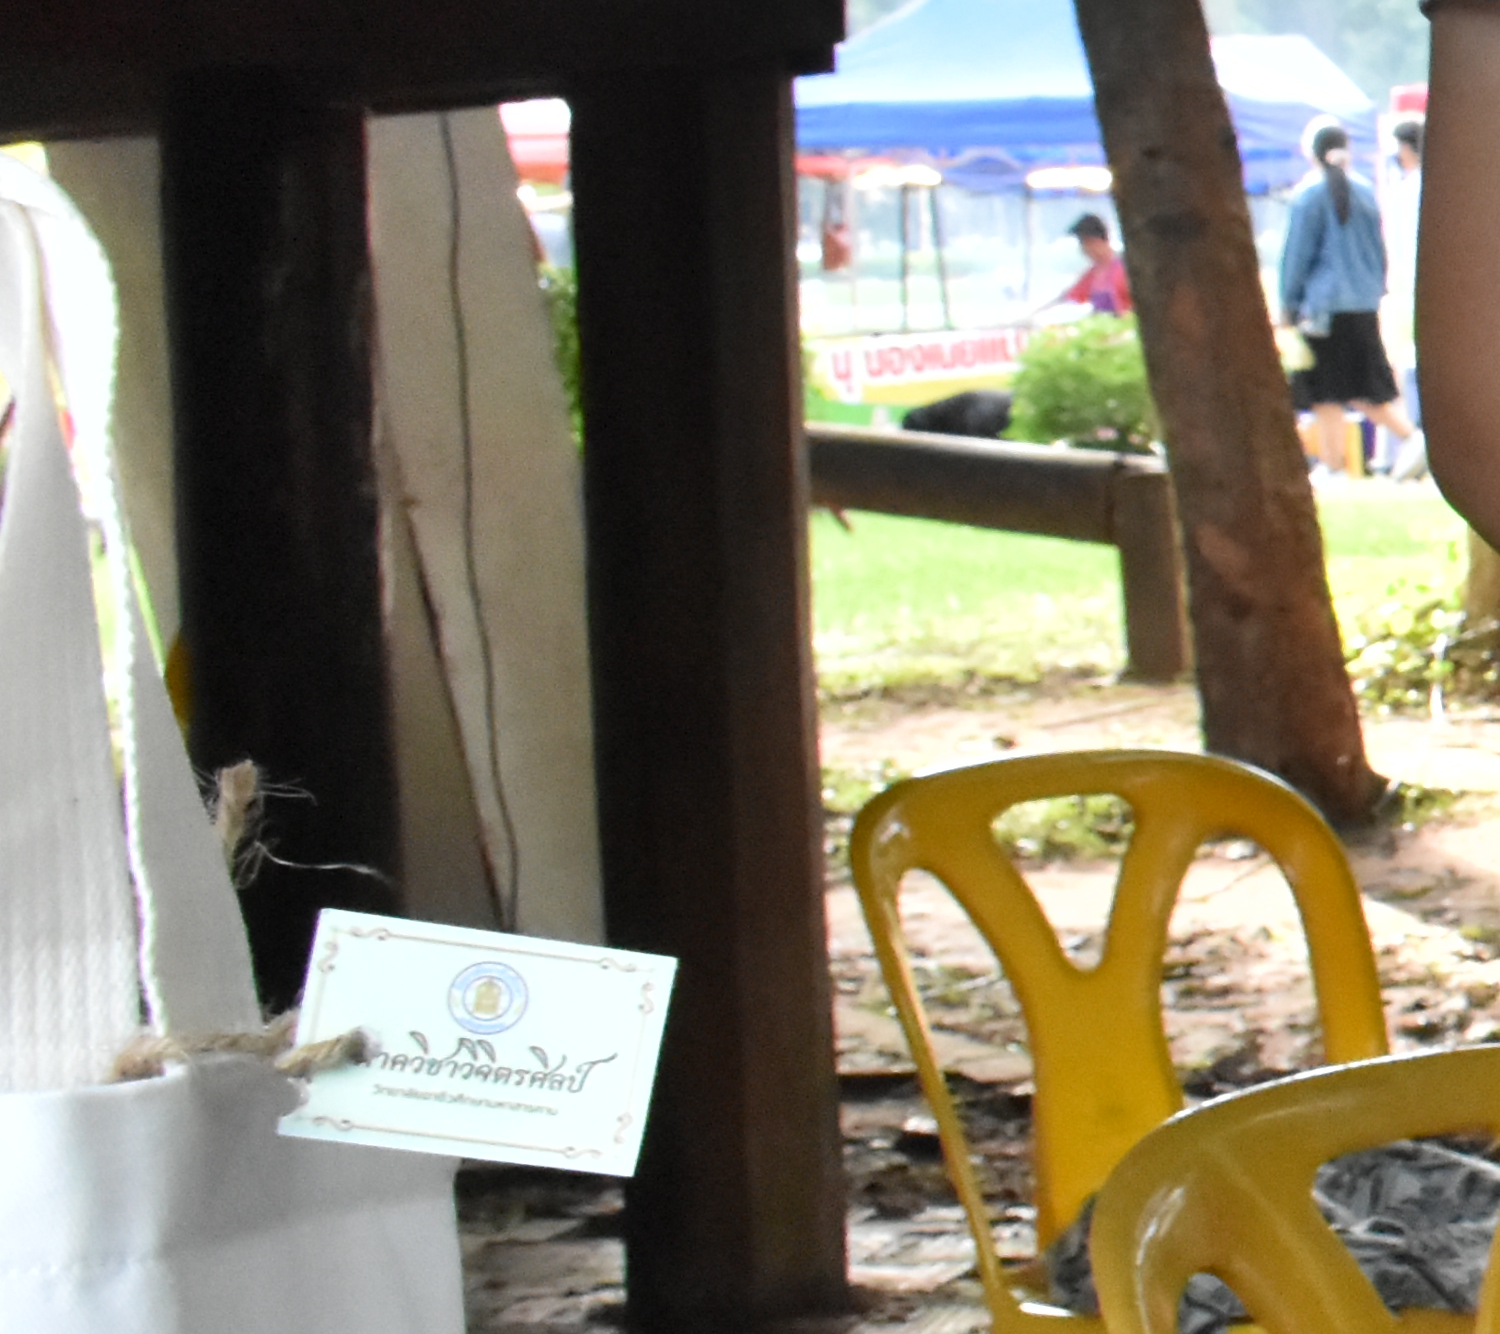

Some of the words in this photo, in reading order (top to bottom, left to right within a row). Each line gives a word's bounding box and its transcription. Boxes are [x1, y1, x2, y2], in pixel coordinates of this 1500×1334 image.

[360, 1030, 618, 1094] าควิชาวิจิตรศิลป์
